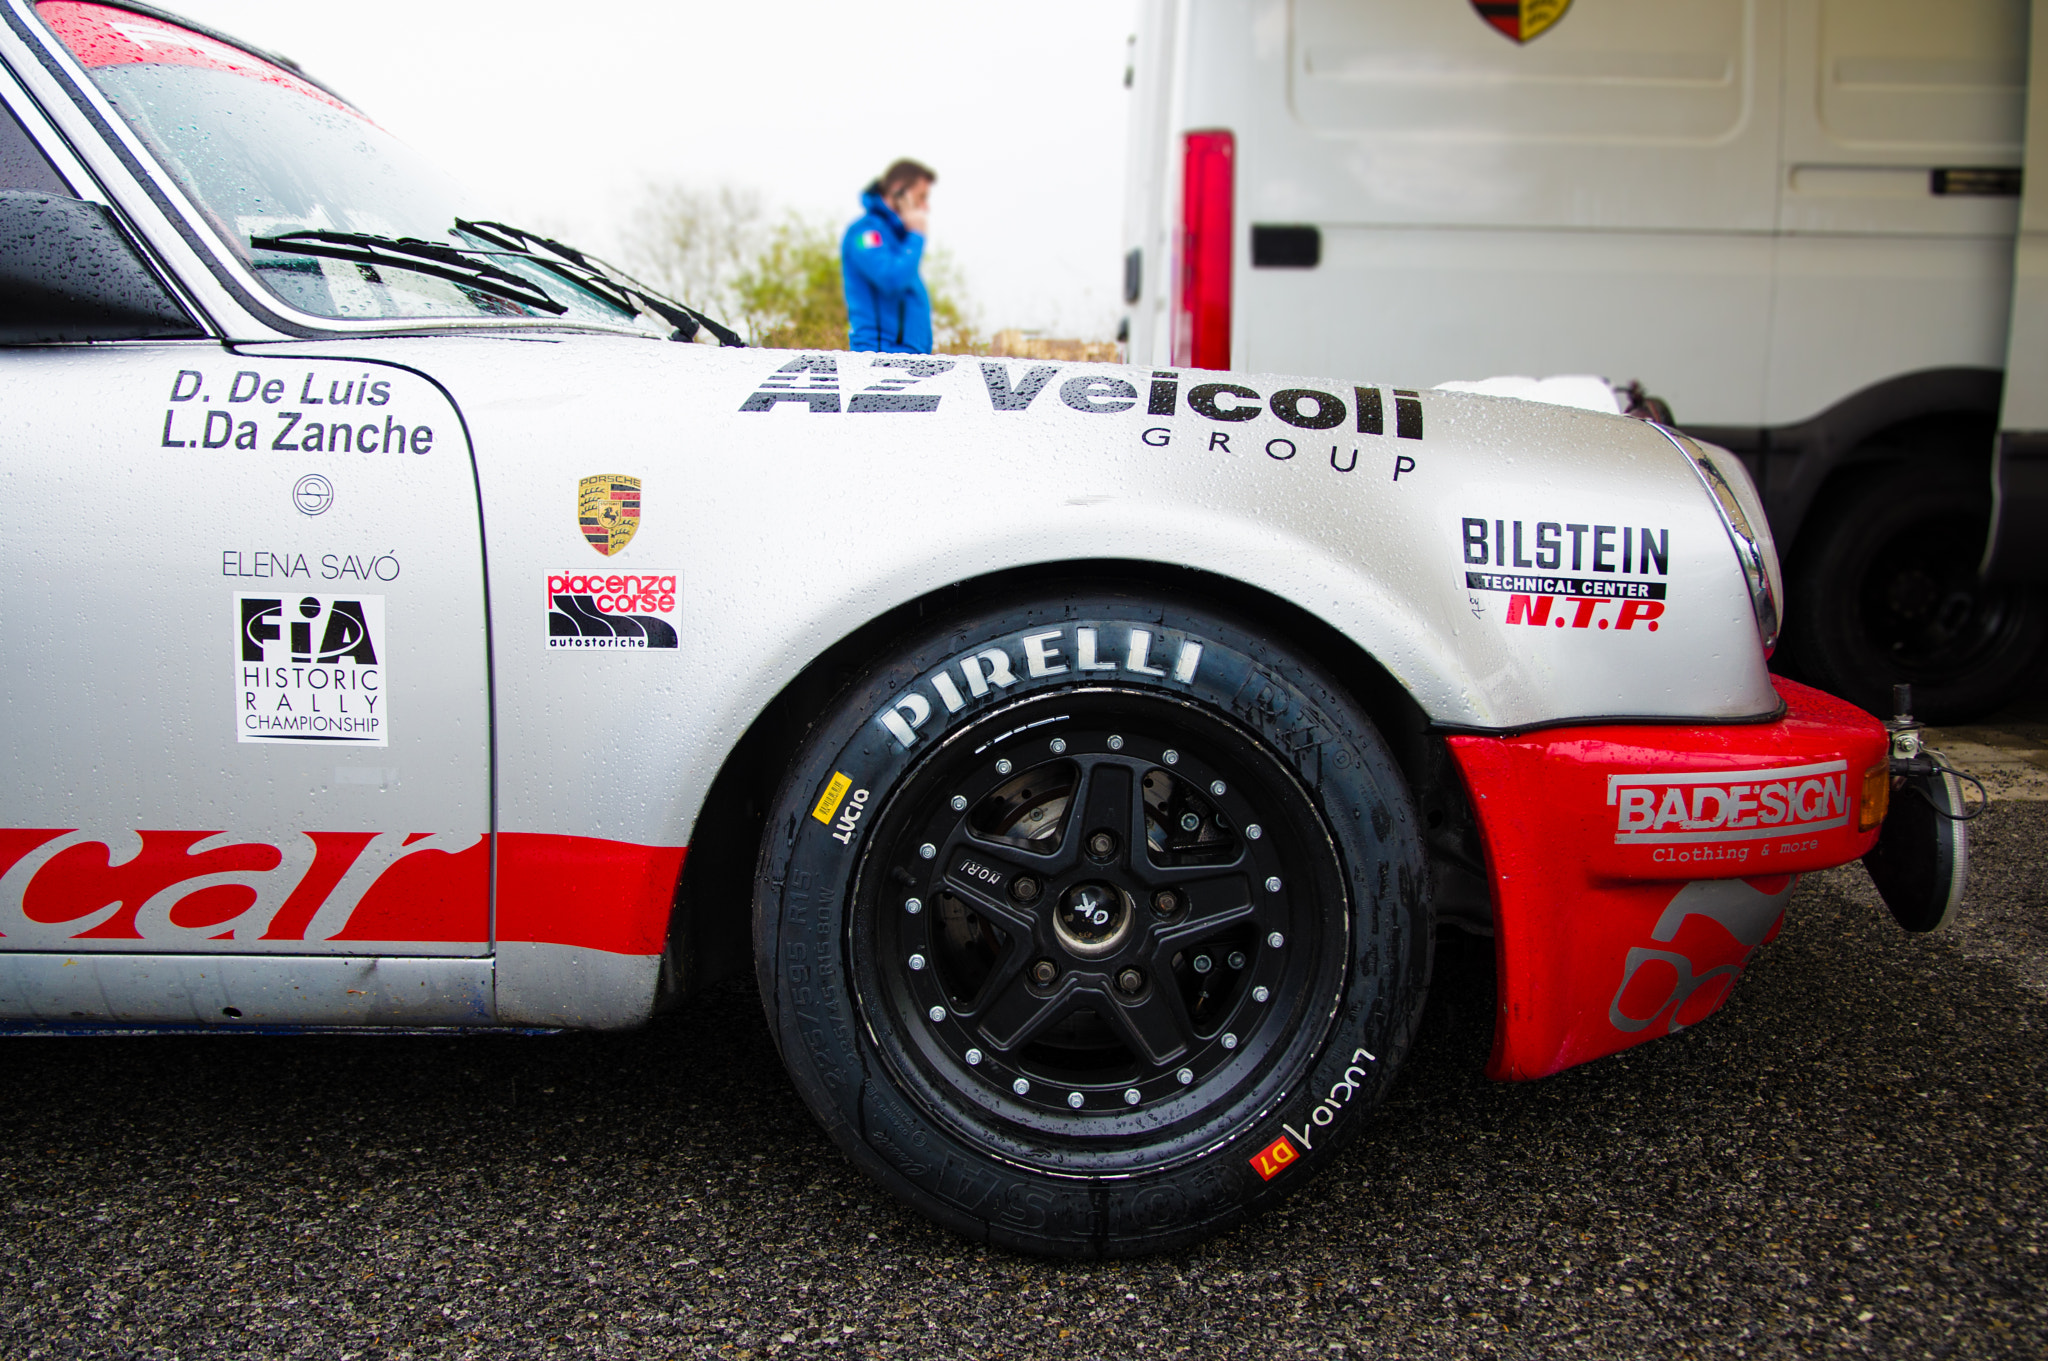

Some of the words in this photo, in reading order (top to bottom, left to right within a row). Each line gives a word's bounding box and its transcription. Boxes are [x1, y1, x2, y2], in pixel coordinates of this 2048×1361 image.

[170, 370, 210, 402] D.
[229, 371, 285, 403] De
[300, 372, 391, 406] Luis
[738, 354, 957, 413] AZ
[976, 361, 1424, 441] Veicoli
[161, 410, 258, 450] L.Da
[272, 412, 433, 455] Zanche
[1142, 427, 1416, 482] GROUP
[580, 475, 641, 487] PORSCHE
[1462, 517, 1669, 576] BILSTEIN
[223, 551, 311, 579] ELENA
[321, 549, 400, 581] SAVÓ
[548, 570, 677, 610] piacenza
[1481, 574, 1577, 594] TECHNICAL
[1582, 580, 1649, 597] CENTER
[596, 593, 676, 613] corse
[1505, 594, 1665, 632] N.T.P.
[550, 637, 645, 648] autostoriche
[243, 667, 378, 691] HISTORIC
[880, 627, 1204, 750] PIRELLI
[246, 692, 378, 714] RALLY
[245, 714, 379, 733] CHAMPIONSHIP
[1652, 845, 1750, 864] Clothing
[1760, 844, 1770, 857] &
[1779, 838, 1819, 854] more
[1074, 893, 1109, 925] OK
[1260, 1141, 1294, 1175] D7
